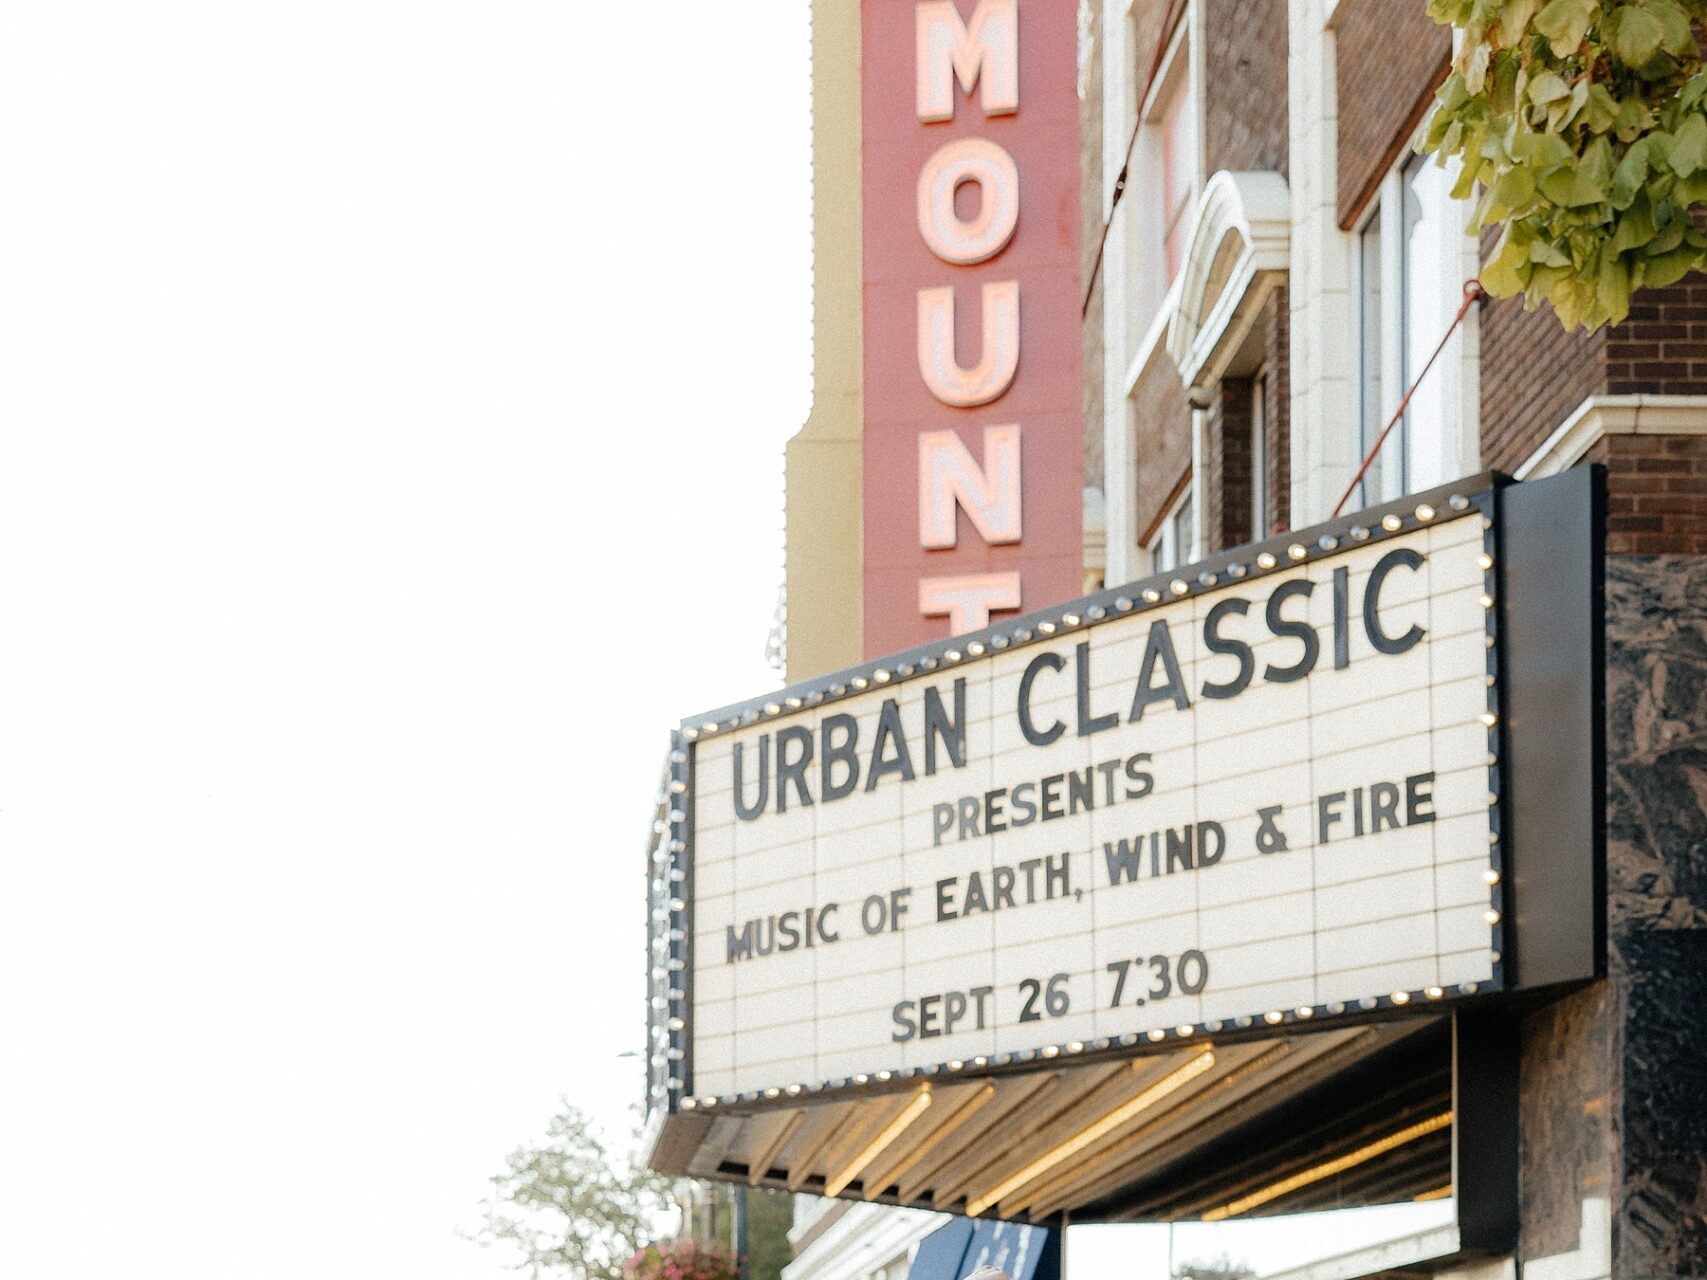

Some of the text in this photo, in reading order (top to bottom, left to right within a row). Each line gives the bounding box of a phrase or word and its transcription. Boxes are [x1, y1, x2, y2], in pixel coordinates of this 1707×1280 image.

[914, 0, 1021, 640] MOUNT
[732, 547, 1427, 822] URBAN CLASSIC
[726, 770, 1437, 964] MUSIC OF EARTH, WIND & FIRE
[932, 752, 1155, 847] PRESENTS
[891, 949, 1209, 1043] SEPT 26 7:30
